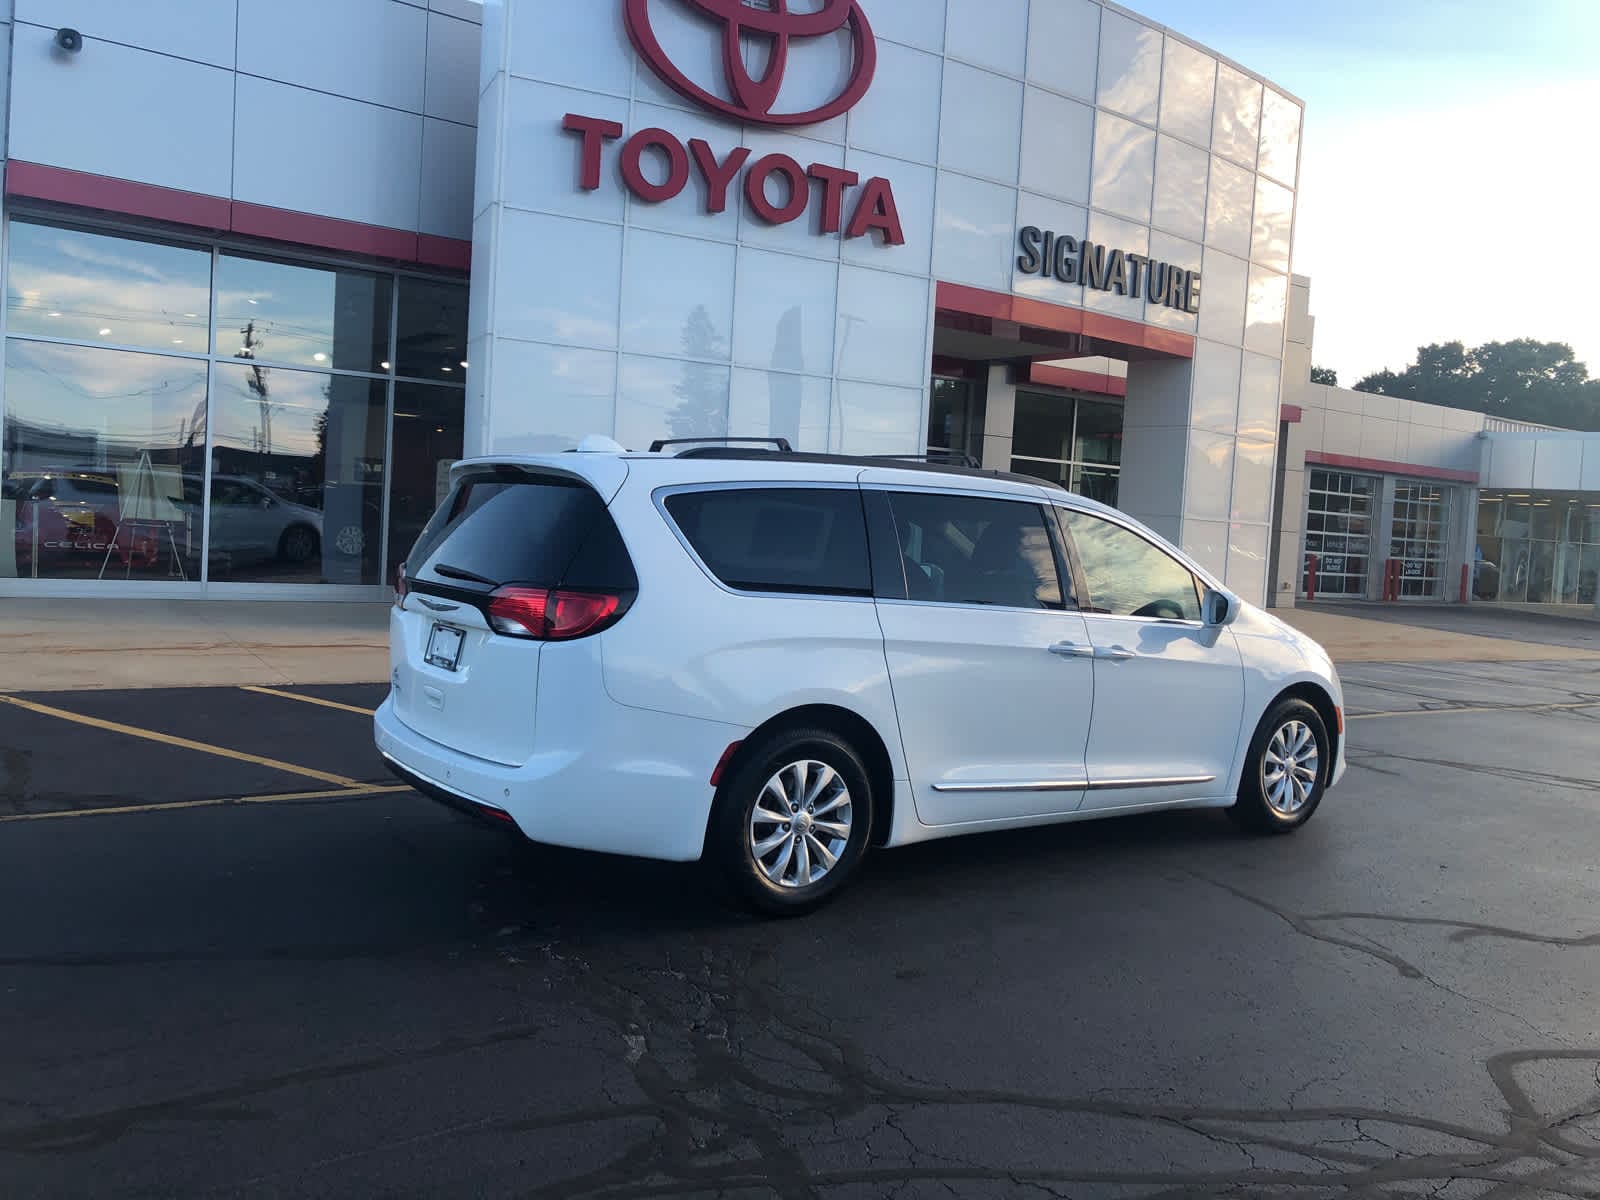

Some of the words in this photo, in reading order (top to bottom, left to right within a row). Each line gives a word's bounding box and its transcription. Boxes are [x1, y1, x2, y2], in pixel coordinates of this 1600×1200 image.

[562, 112, 905, 245] TOYOTA
[1017, 225, 1201, 313] SIGNATURE
[43, 541, 119, 550] CELICA
